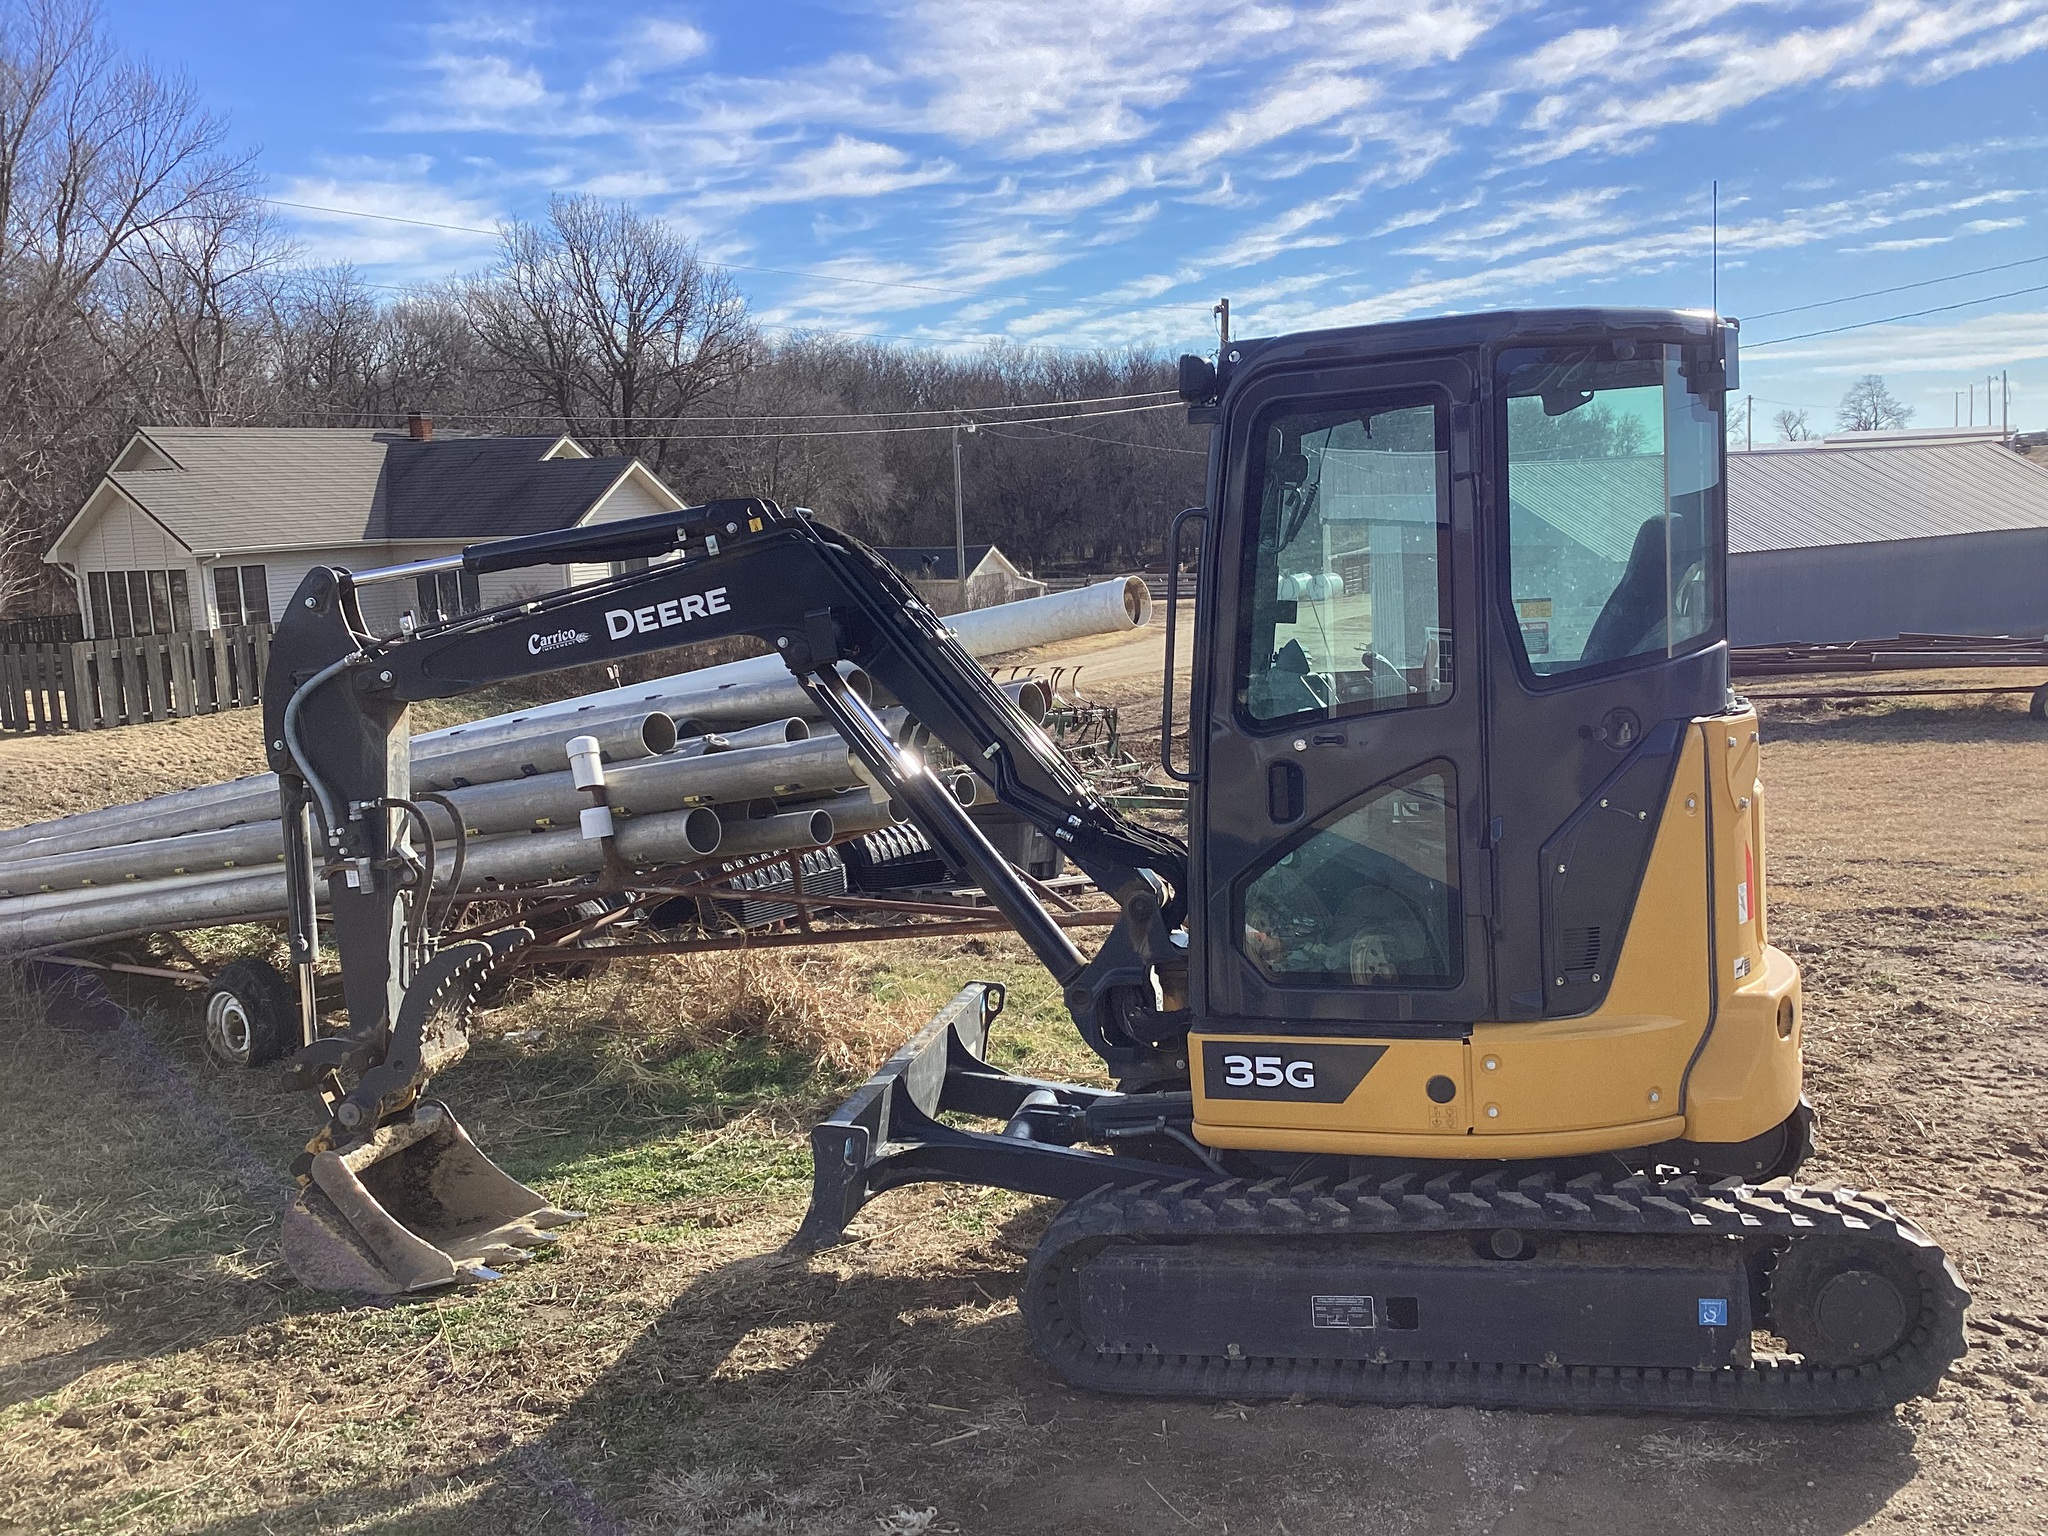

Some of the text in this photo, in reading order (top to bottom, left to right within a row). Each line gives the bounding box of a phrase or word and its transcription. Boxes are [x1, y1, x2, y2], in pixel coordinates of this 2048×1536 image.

[604, 587, 731, 640] DEERE
[528, 629, 576, 655] Carrico
[542, 641, 576, 652] IMPLEMENT
[1224, 1055, 1315, 1088] 35G
